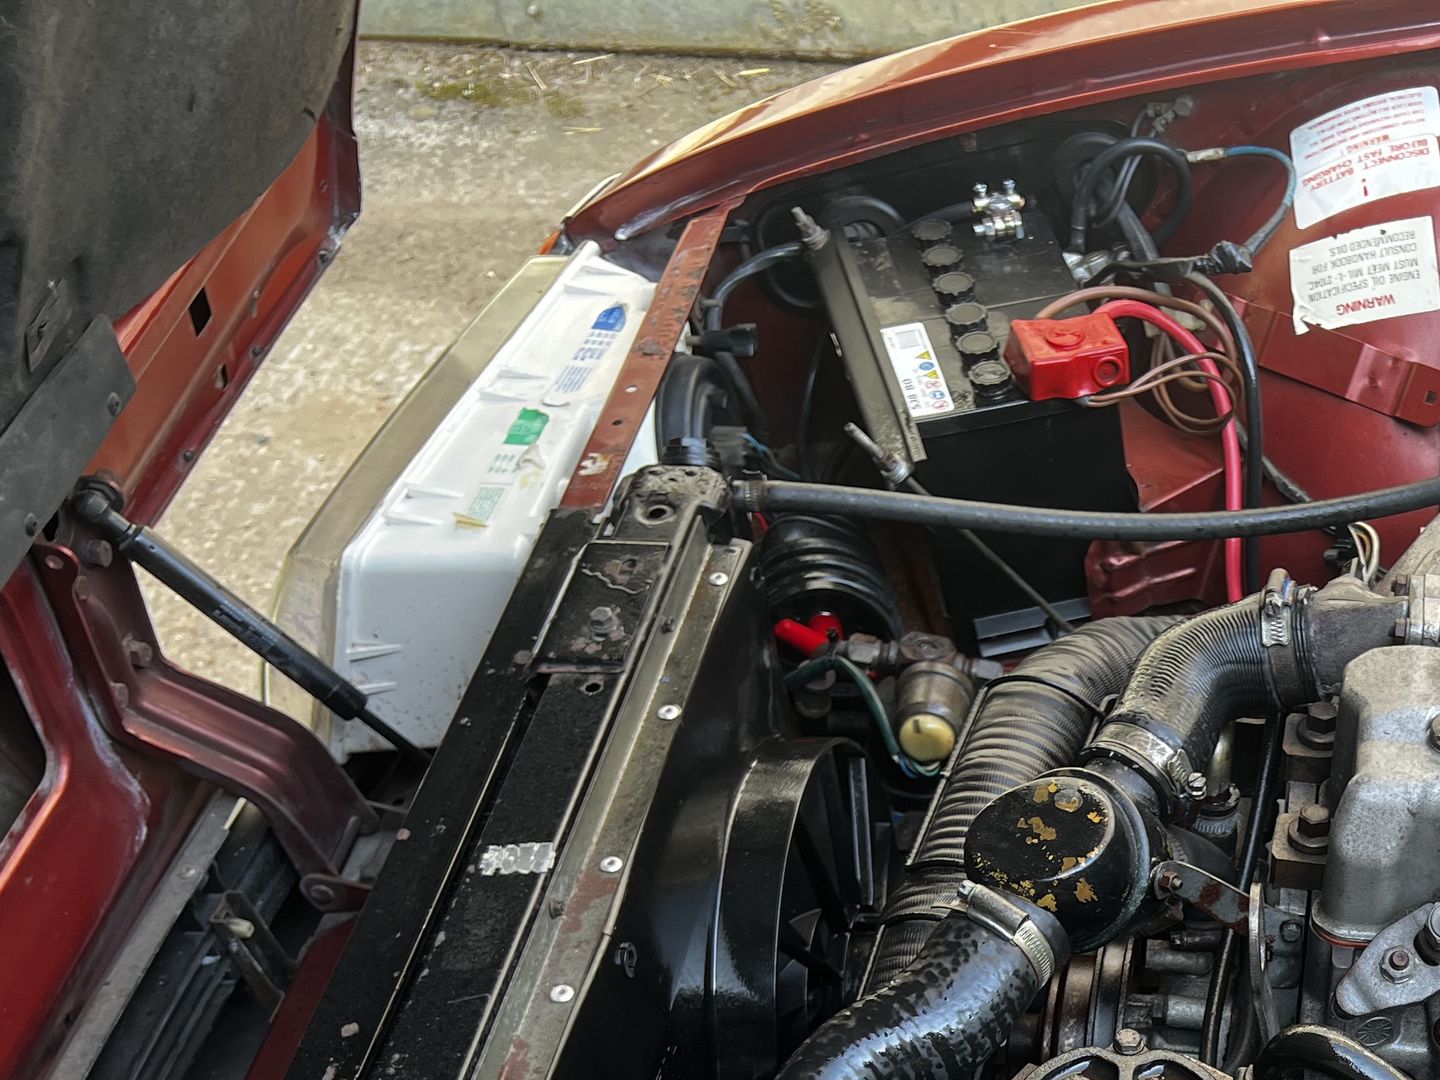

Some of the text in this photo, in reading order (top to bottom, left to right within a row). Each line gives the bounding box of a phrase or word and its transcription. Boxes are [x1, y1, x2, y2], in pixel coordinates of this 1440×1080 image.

[1302, 138, 1428, 187] BEFORE FAST CHARGING
[1310, 148, 1430, 192] DISCONNECT BATTERY
[1349, 230, 1416, 252] RECOMMENDED
[1311, 242, 1417, 275] CONSULT HANDBOOK FOR
[1367, 262, 1390, 275] MEET
[1394, 258, 1419, 271] MUST
[1308, 269, 1420, 303] ENGINE OIL SPECIFICATION
[1336, 294, 1396, 316] WARNING
